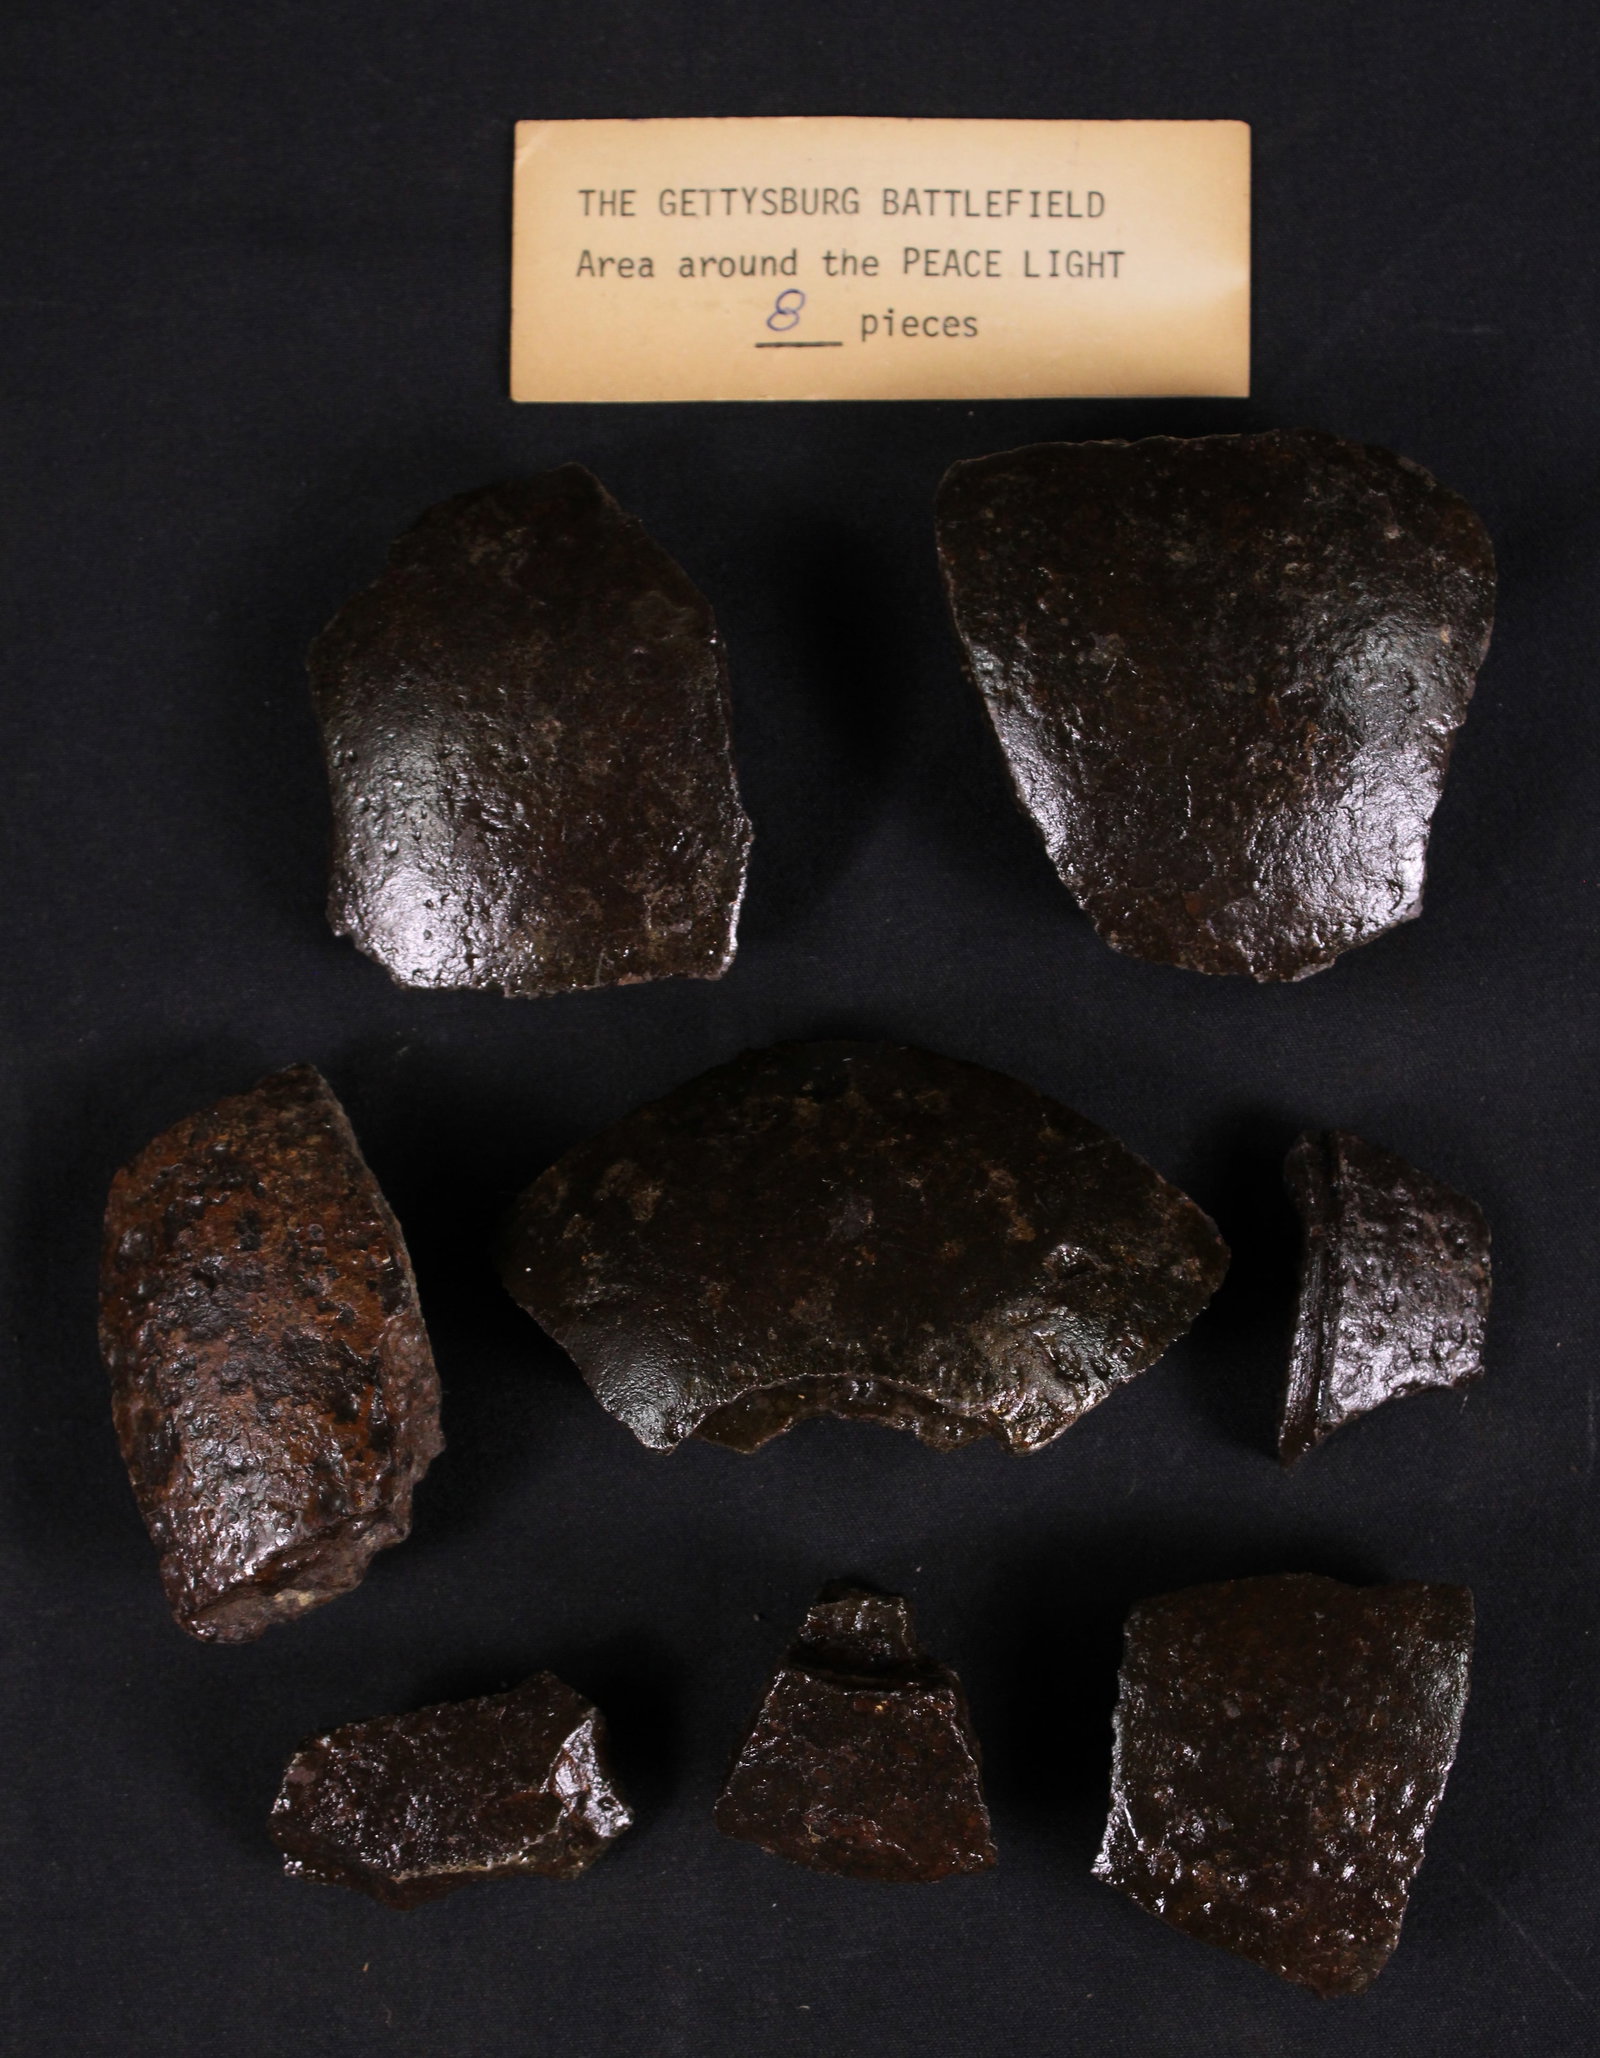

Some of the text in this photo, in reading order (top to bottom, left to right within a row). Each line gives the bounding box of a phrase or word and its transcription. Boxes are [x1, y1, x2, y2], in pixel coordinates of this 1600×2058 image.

[577, 186, 1106, 219] THE GETTYSBURG BATTLEFIELD
[576, 246, 1126, 279] Area around the PEACE LIGHT
[766, 288, 978, 343] 8 pieces
